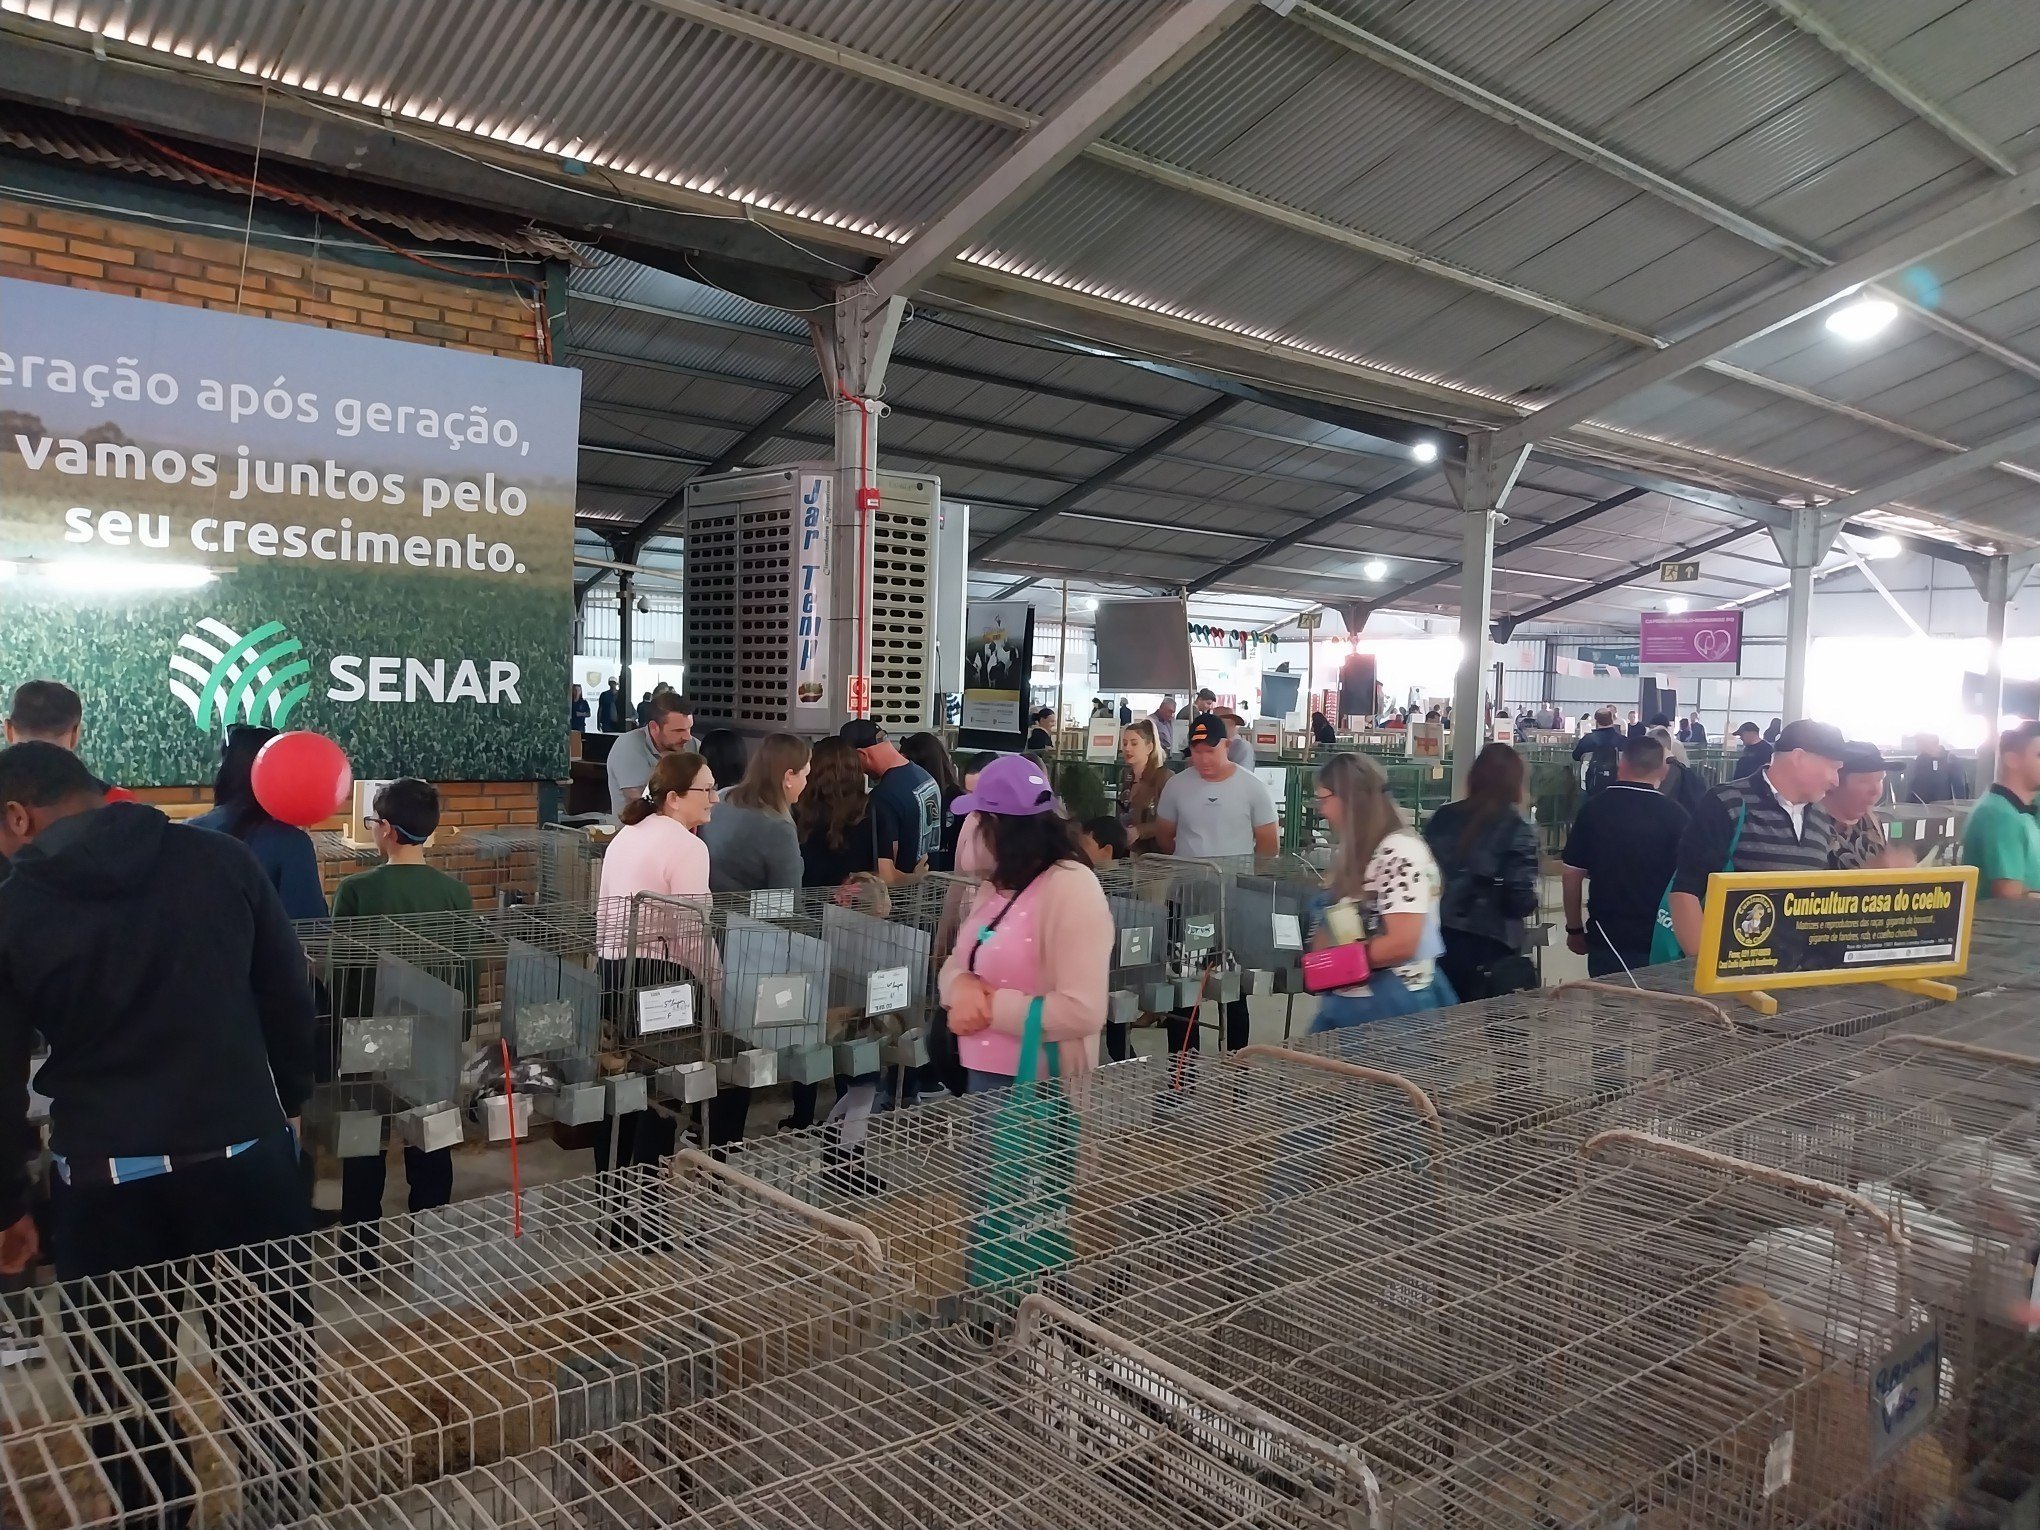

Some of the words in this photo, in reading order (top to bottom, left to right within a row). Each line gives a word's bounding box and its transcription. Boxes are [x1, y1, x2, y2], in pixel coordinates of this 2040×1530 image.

[197, 375, 319, 424] após
[335, 398, 530, 457] geração,
[15, 434, 218, 488] vamos
[229, 445, 406, 505] juntos
[422, 473, 527, 518] pelo
[64, 507, 170, 548] seu
[190, 517, 526, 574] crescimento.
[803, 479, 822, 550] Jar
[798, 564, 822, 671] Temp
[326, 655, 522, 704] SENAR
[1783, 891, 1858, 917] Cunicultura
[1861, 894, 1890, 913] casa
[1893, 888, 1912, 911] do
[1913, 886, 1951, 910] coelho
